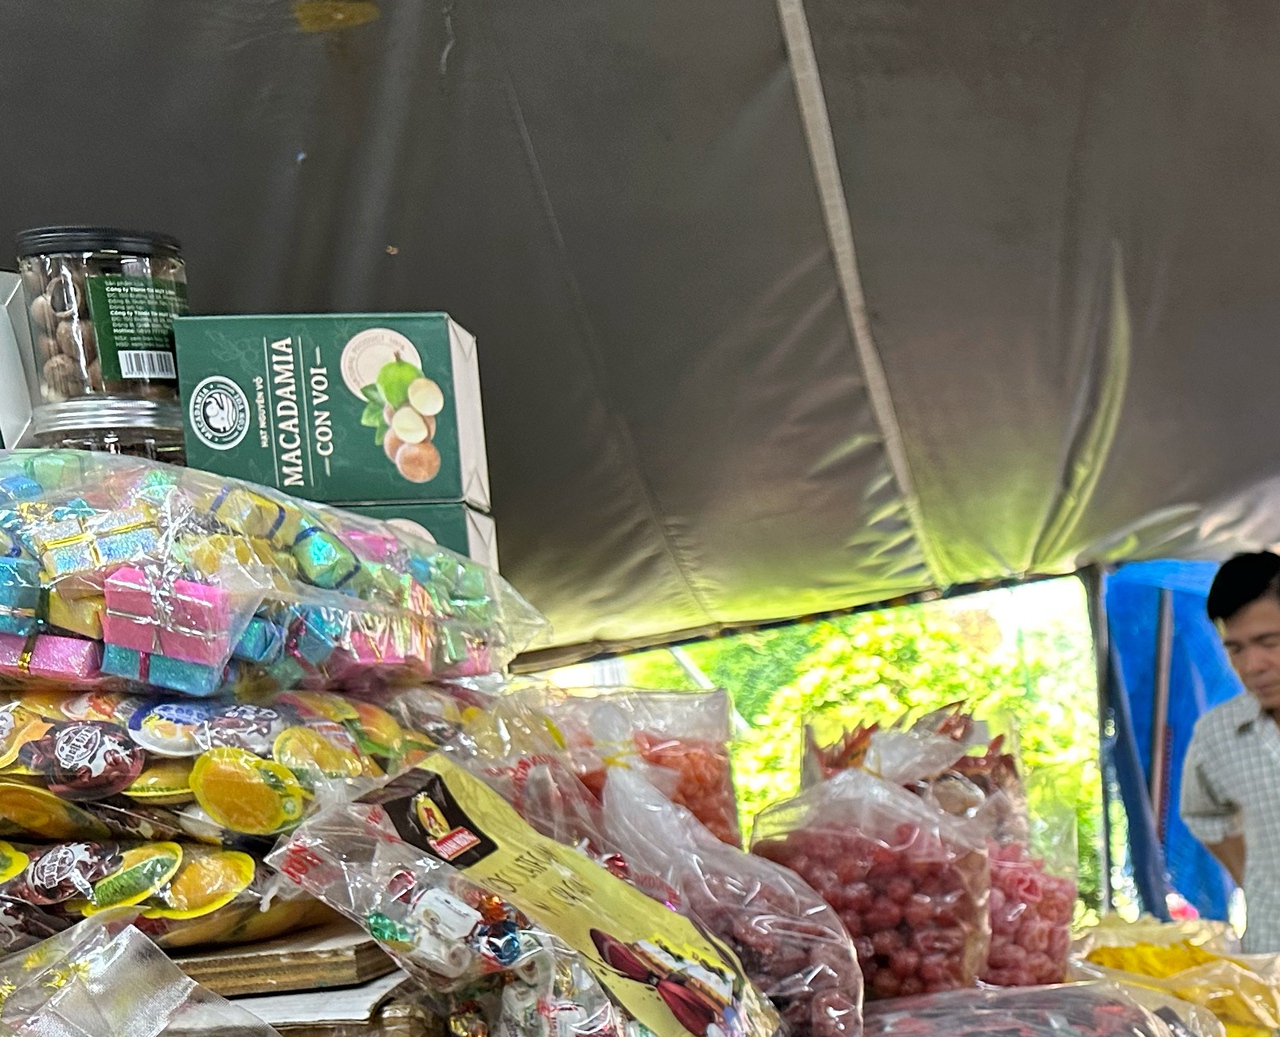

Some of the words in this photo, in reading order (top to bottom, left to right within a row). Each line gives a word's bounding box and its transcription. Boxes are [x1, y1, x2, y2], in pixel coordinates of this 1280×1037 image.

[310, 367, 329, 406] VOI
[271, 336, 304, 487] MACADAMIA
[314, 410, 334, 457] CON
